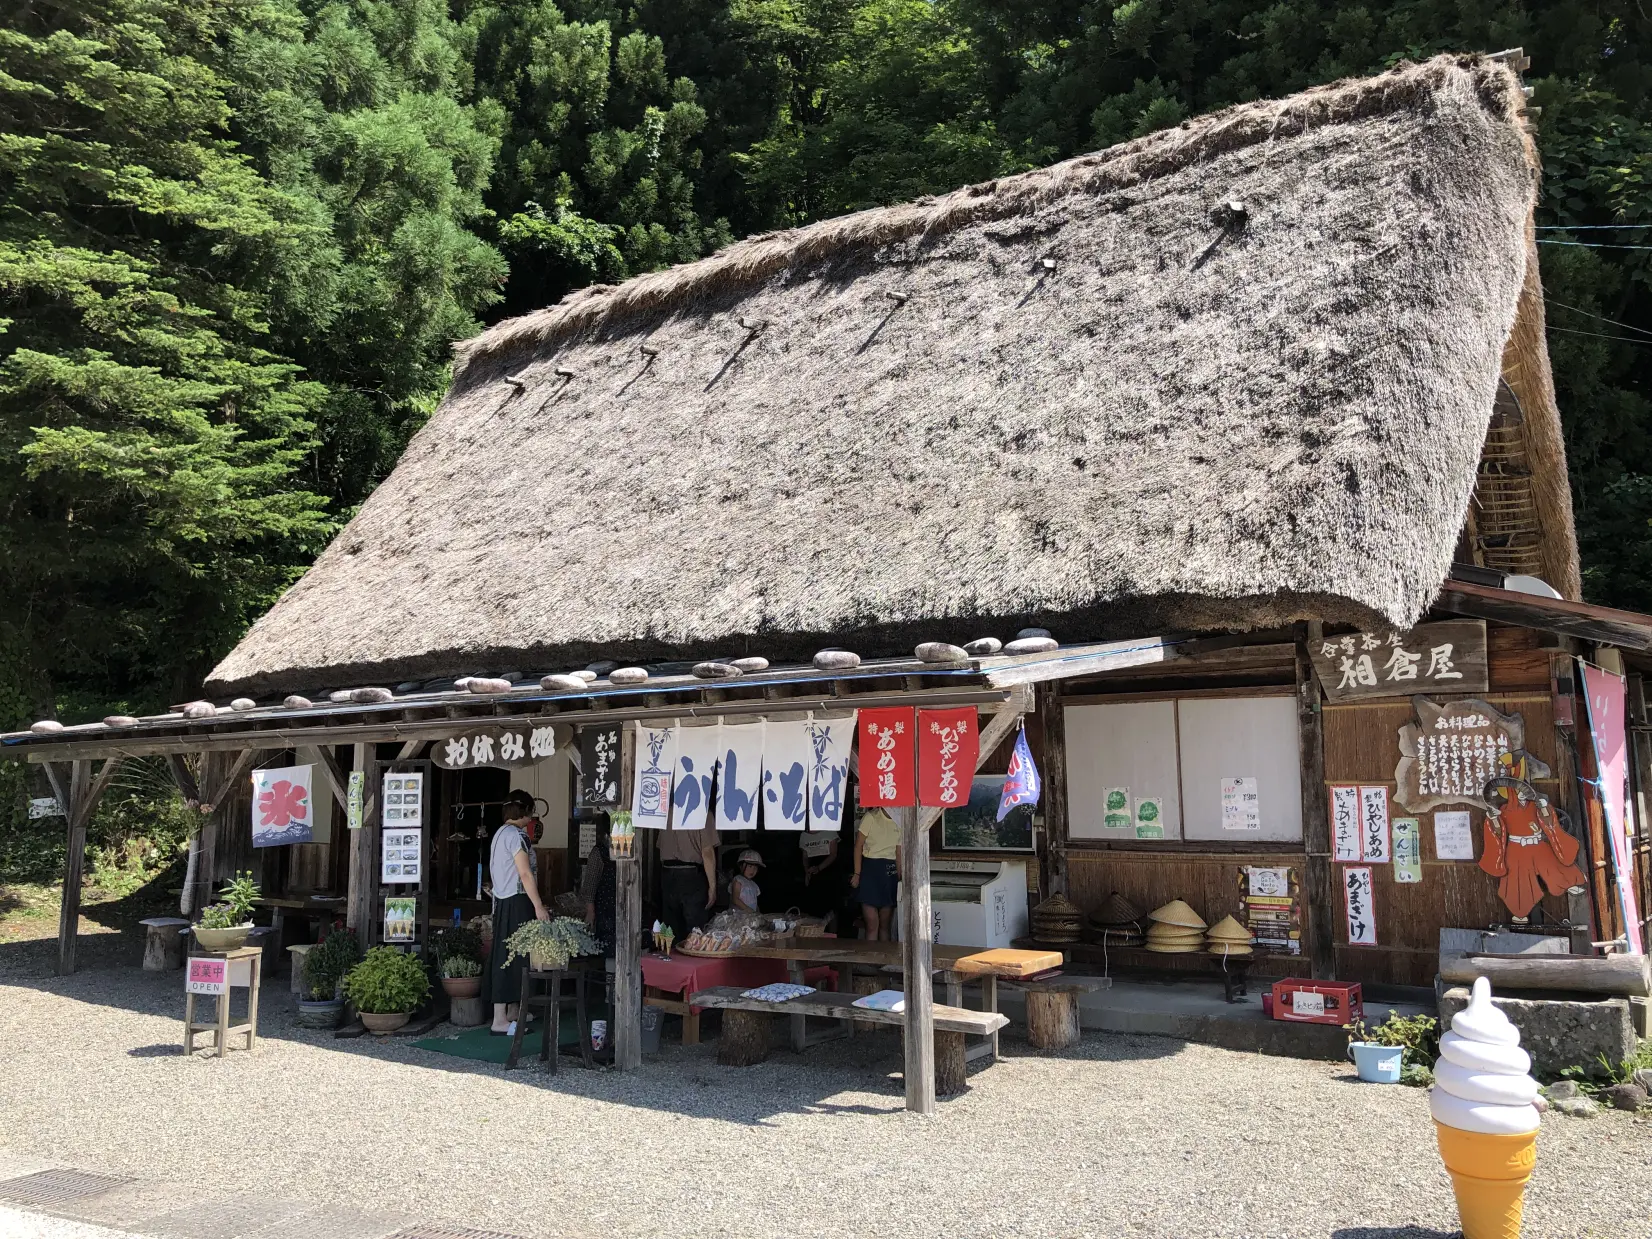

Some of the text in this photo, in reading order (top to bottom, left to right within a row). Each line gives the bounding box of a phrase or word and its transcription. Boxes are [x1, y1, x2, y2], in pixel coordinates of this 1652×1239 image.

[1336, 643, 1463, 690] 相倉屋
[868, 721, 904, 735] 特製
[930, 720, 967, 734] 特製
[1435, 714, 1491, 731] お料理品
[445, 726, 556, 767] お休み処
[877, 727, 896, 800] あめ湯
[939, 727, 959, 803] ひやしあめ
[1462, 734, 1473, 796] なめこうどん
[259, 780, 307, 826] 氷
[1335, 802, 1353, 857] あまざけ
[1366, 803, 1382, 858] ひやしあめ
[1396, 823, 1412, 880] ぜんざい
[1347, 872, 1366, 940] あまざけ
[1362, 872, 1370, 894] ひやし
[191, 964, 223, 978] 営業中
[192, 983, 219, 991] OPEN
